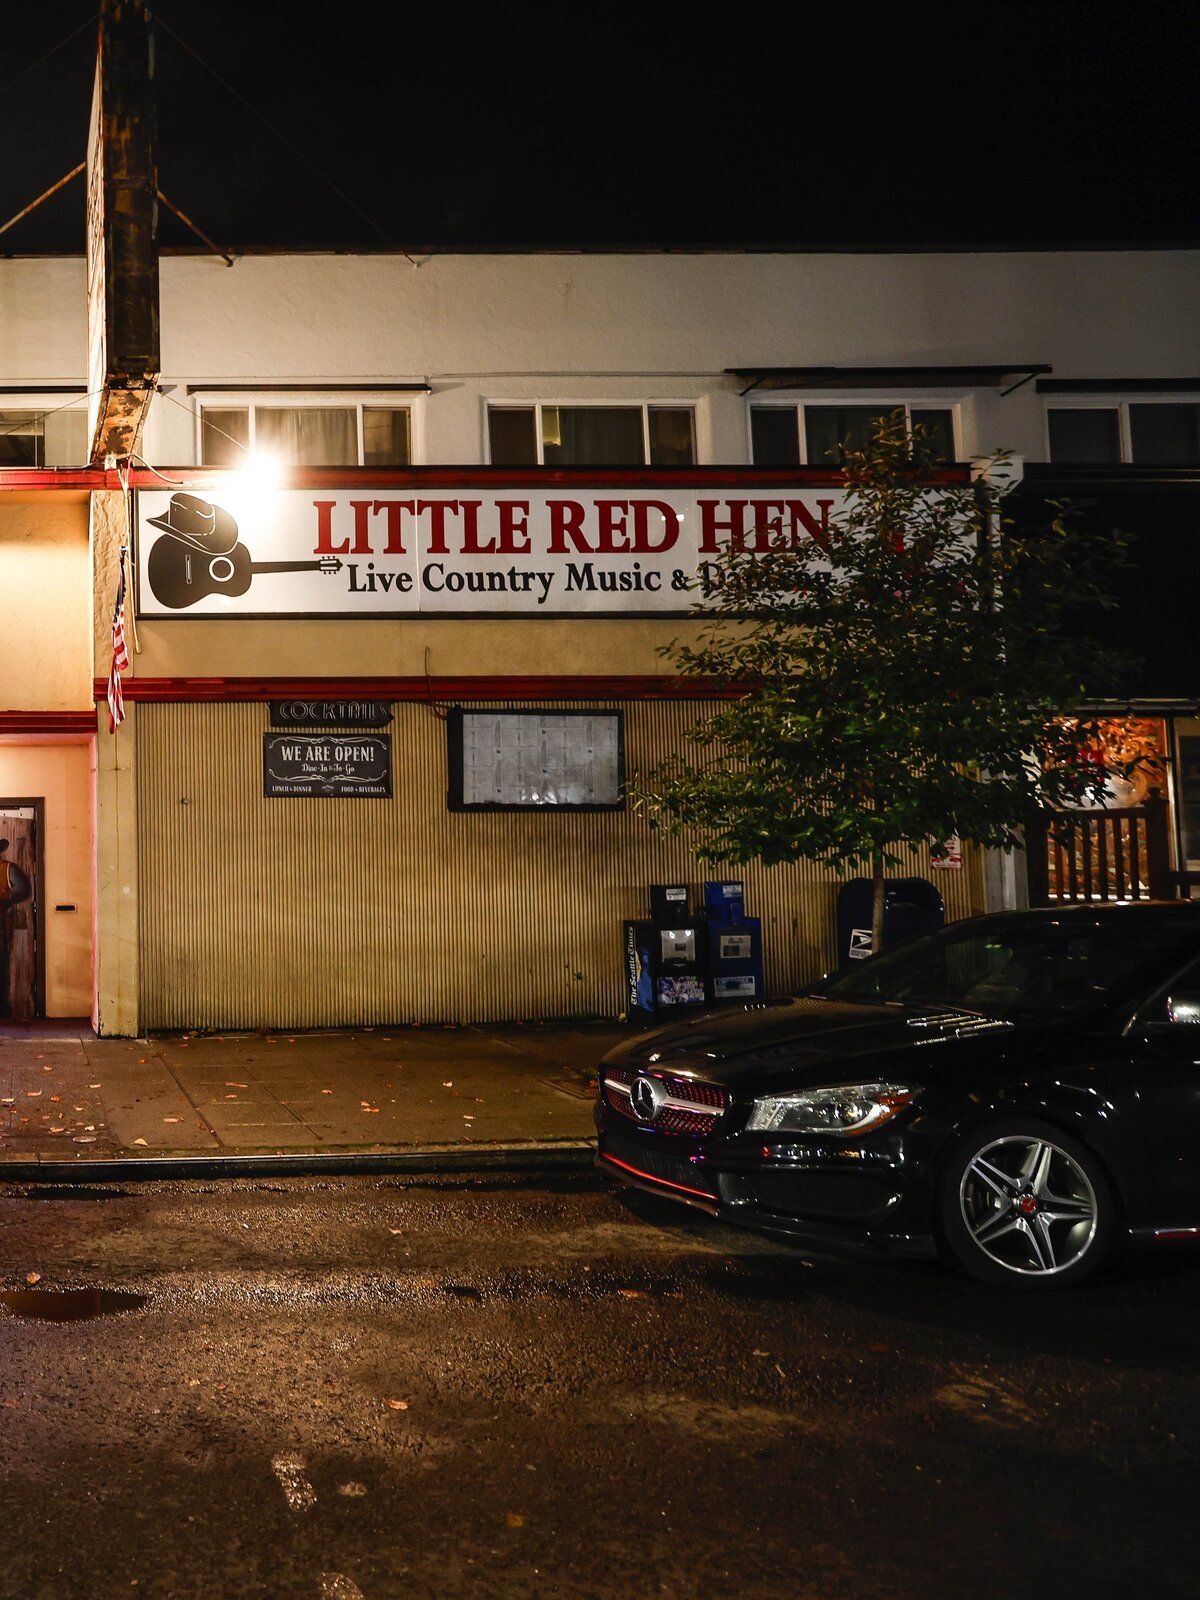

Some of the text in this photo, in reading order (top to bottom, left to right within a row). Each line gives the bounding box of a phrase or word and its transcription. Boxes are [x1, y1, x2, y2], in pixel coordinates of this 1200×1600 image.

[313, 499, 835, 554] LITTLE RED HEN
[347, 562, 413, 593] Live
[422, 563, 555, 604] Country
[564, 562, 665, 593] Music
[671, 565, 689, 592] &
[279, 701, 388, 720] COCKTAILS
[281, 746, 374, 761] WE ARE OPEN!
[627, 926, 635, 955] Times
[629, 955, 637, 986] Seattle
